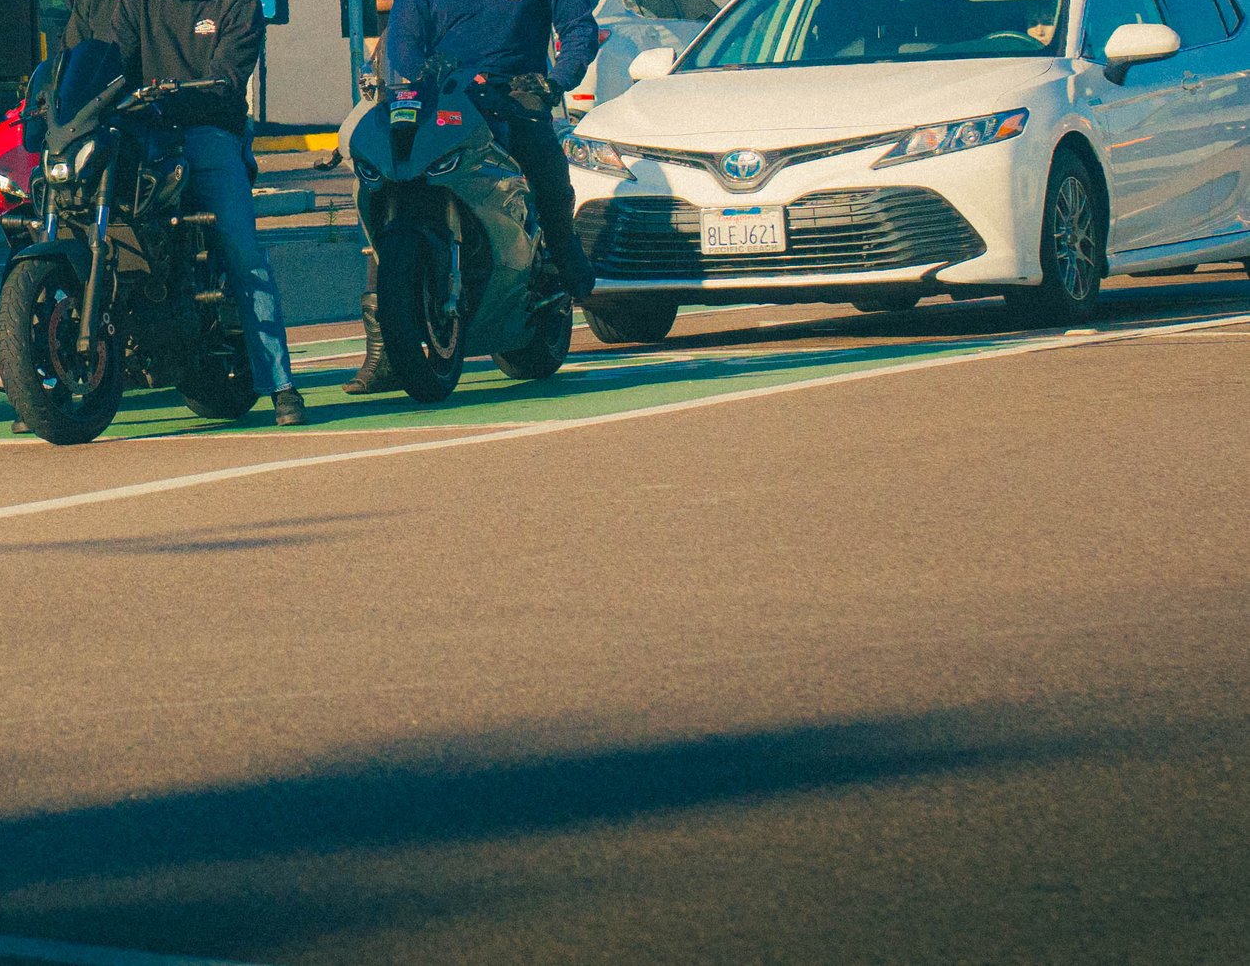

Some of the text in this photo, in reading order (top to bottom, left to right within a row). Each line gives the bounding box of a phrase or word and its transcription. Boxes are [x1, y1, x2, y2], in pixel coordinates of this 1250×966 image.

[707, 224, 778, 245] 8LEJ621
[708, 244, 778, 253] PACIFIC BEACH
